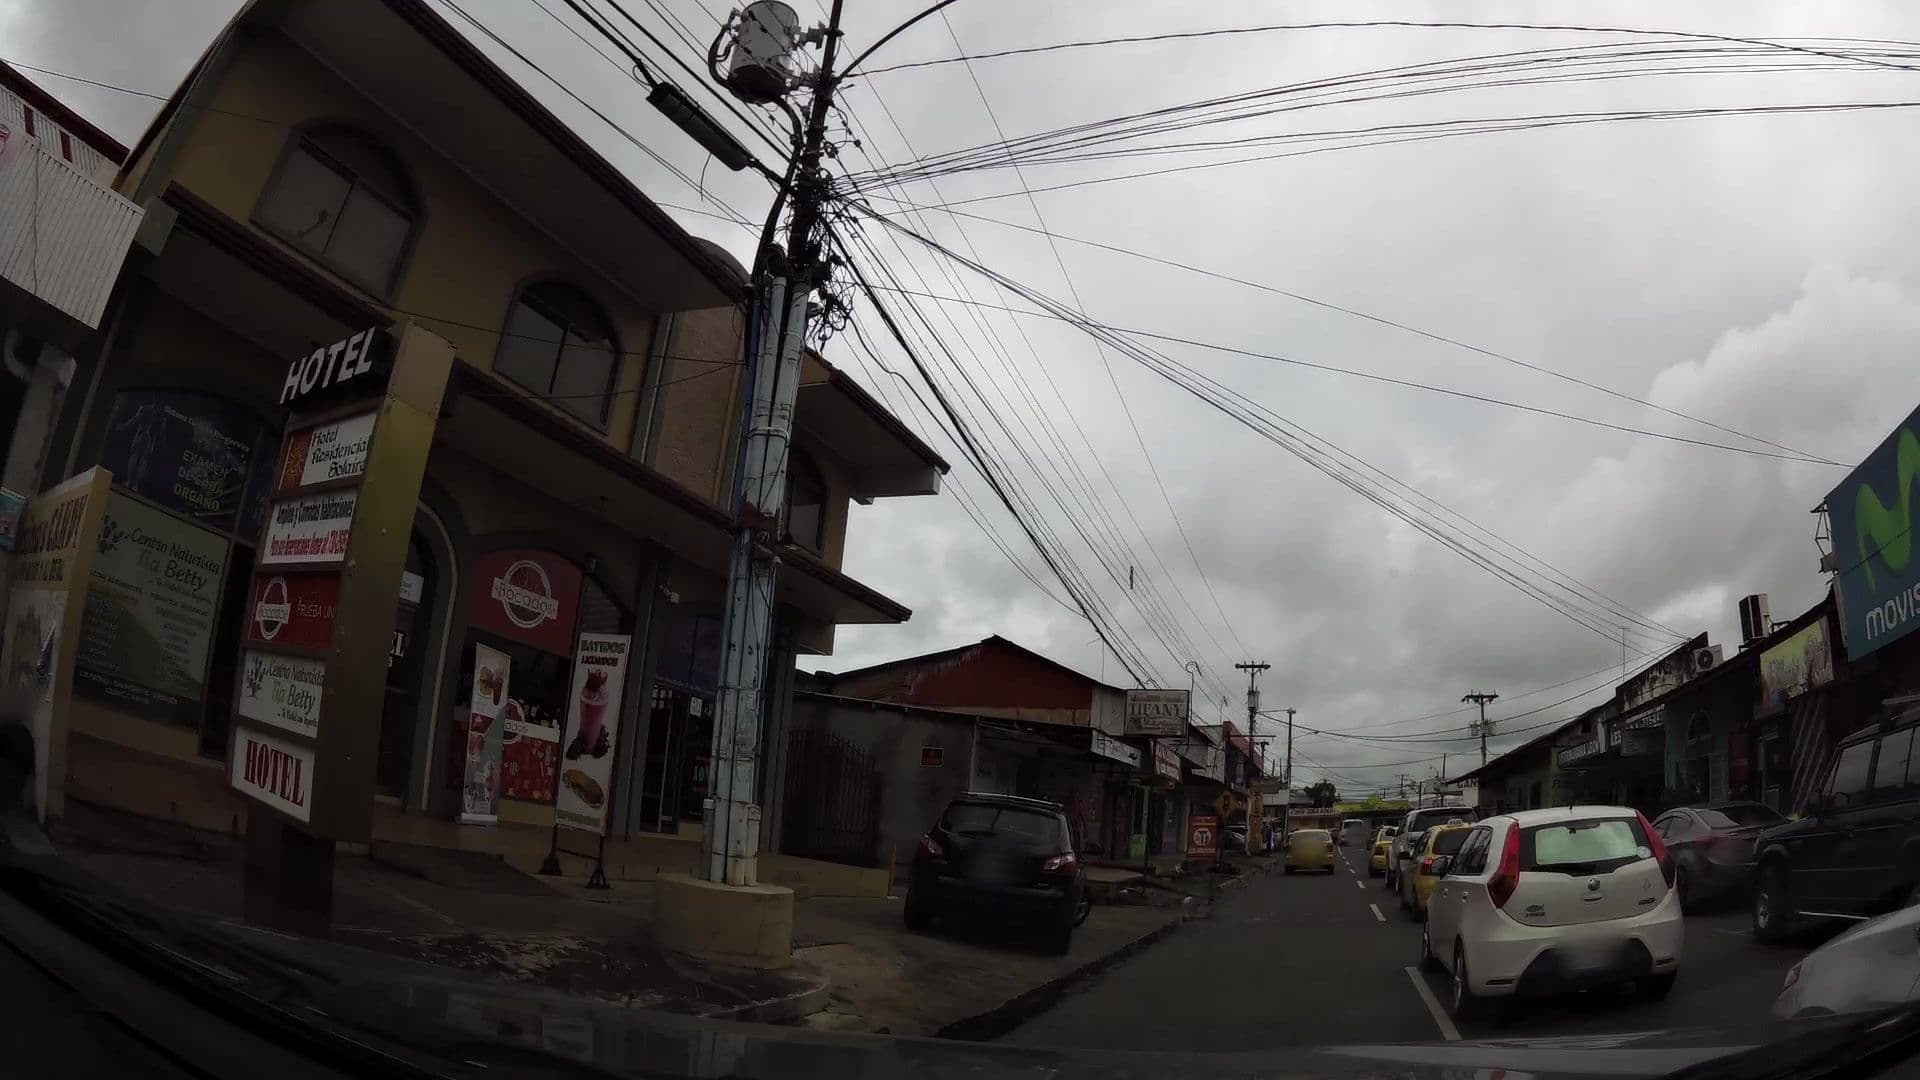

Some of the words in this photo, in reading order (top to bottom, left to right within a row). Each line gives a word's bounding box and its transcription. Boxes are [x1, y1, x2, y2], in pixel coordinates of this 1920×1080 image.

[279, 325, 377, 405] HOTEL
[312, 424, 339, 447] Hotel
[182, 448, 230, 479] EXAMEN
[173, 483, 220, 511] ORGANO
[132, 527, 168, 553] Centro
[164, 560, 208, 594] Betty
[268, 658, 292, 681] Centro
[286, 684, 317, 716] Betty
[1128, 702, 1186, 717] TIFANY
[244, 739, 306, 807] HOTEL
